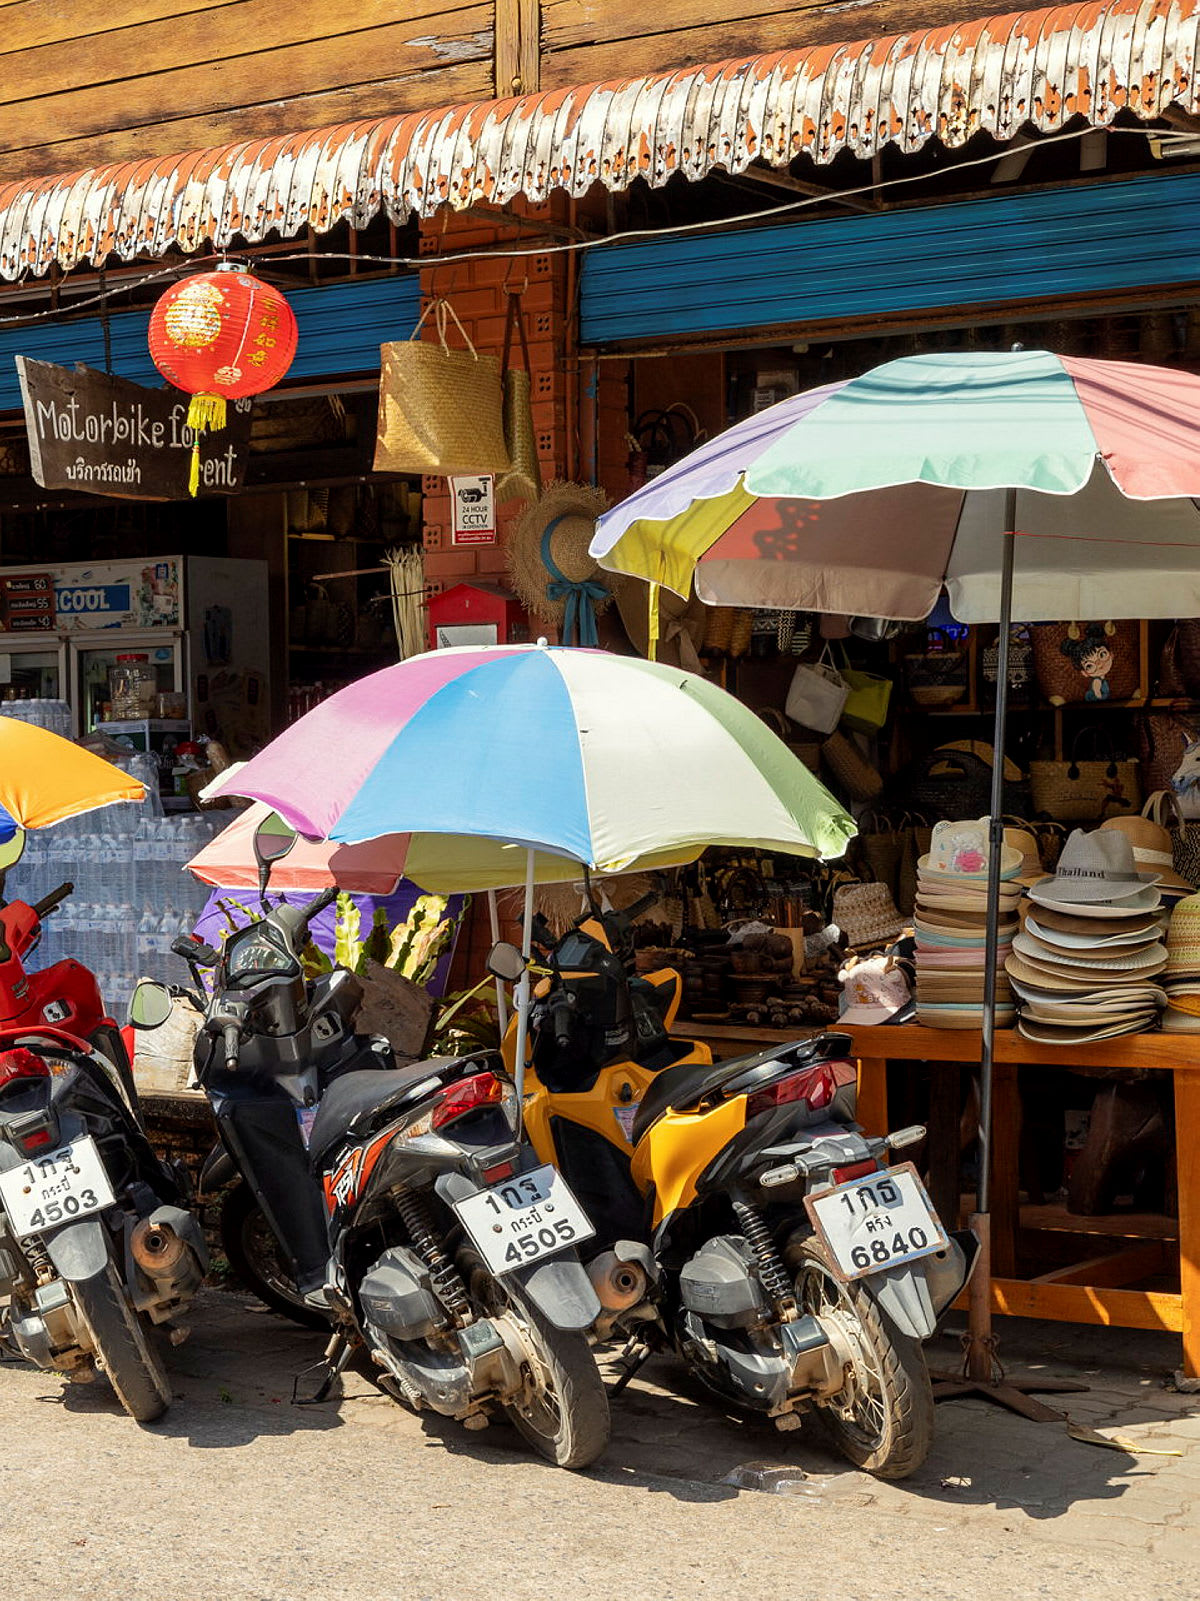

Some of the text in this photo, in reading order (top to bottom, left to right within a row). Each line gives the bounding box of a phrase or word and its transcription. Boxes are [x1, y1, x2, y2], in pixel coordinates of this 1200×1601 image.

[36, 398, 165, 449] Motorbike
[65, 456, 141, 484] บริการรถเช่า
[462, 514, 488, 524] CCTV
[1058, 866, 1105, 879] Thailand
[41, 1175, 71, 1200] กระบี่
[840, 1178, 897, 1216] 1กธ
[30, 1188, 99, 1227] 4503
[510, 1206, 543, 1233] กระบี่
[865, 1214, 893, 1234] ตรัง
[504, 1218, 576, 1263] 4505
[851, 1226, 928, 1269] 6840
